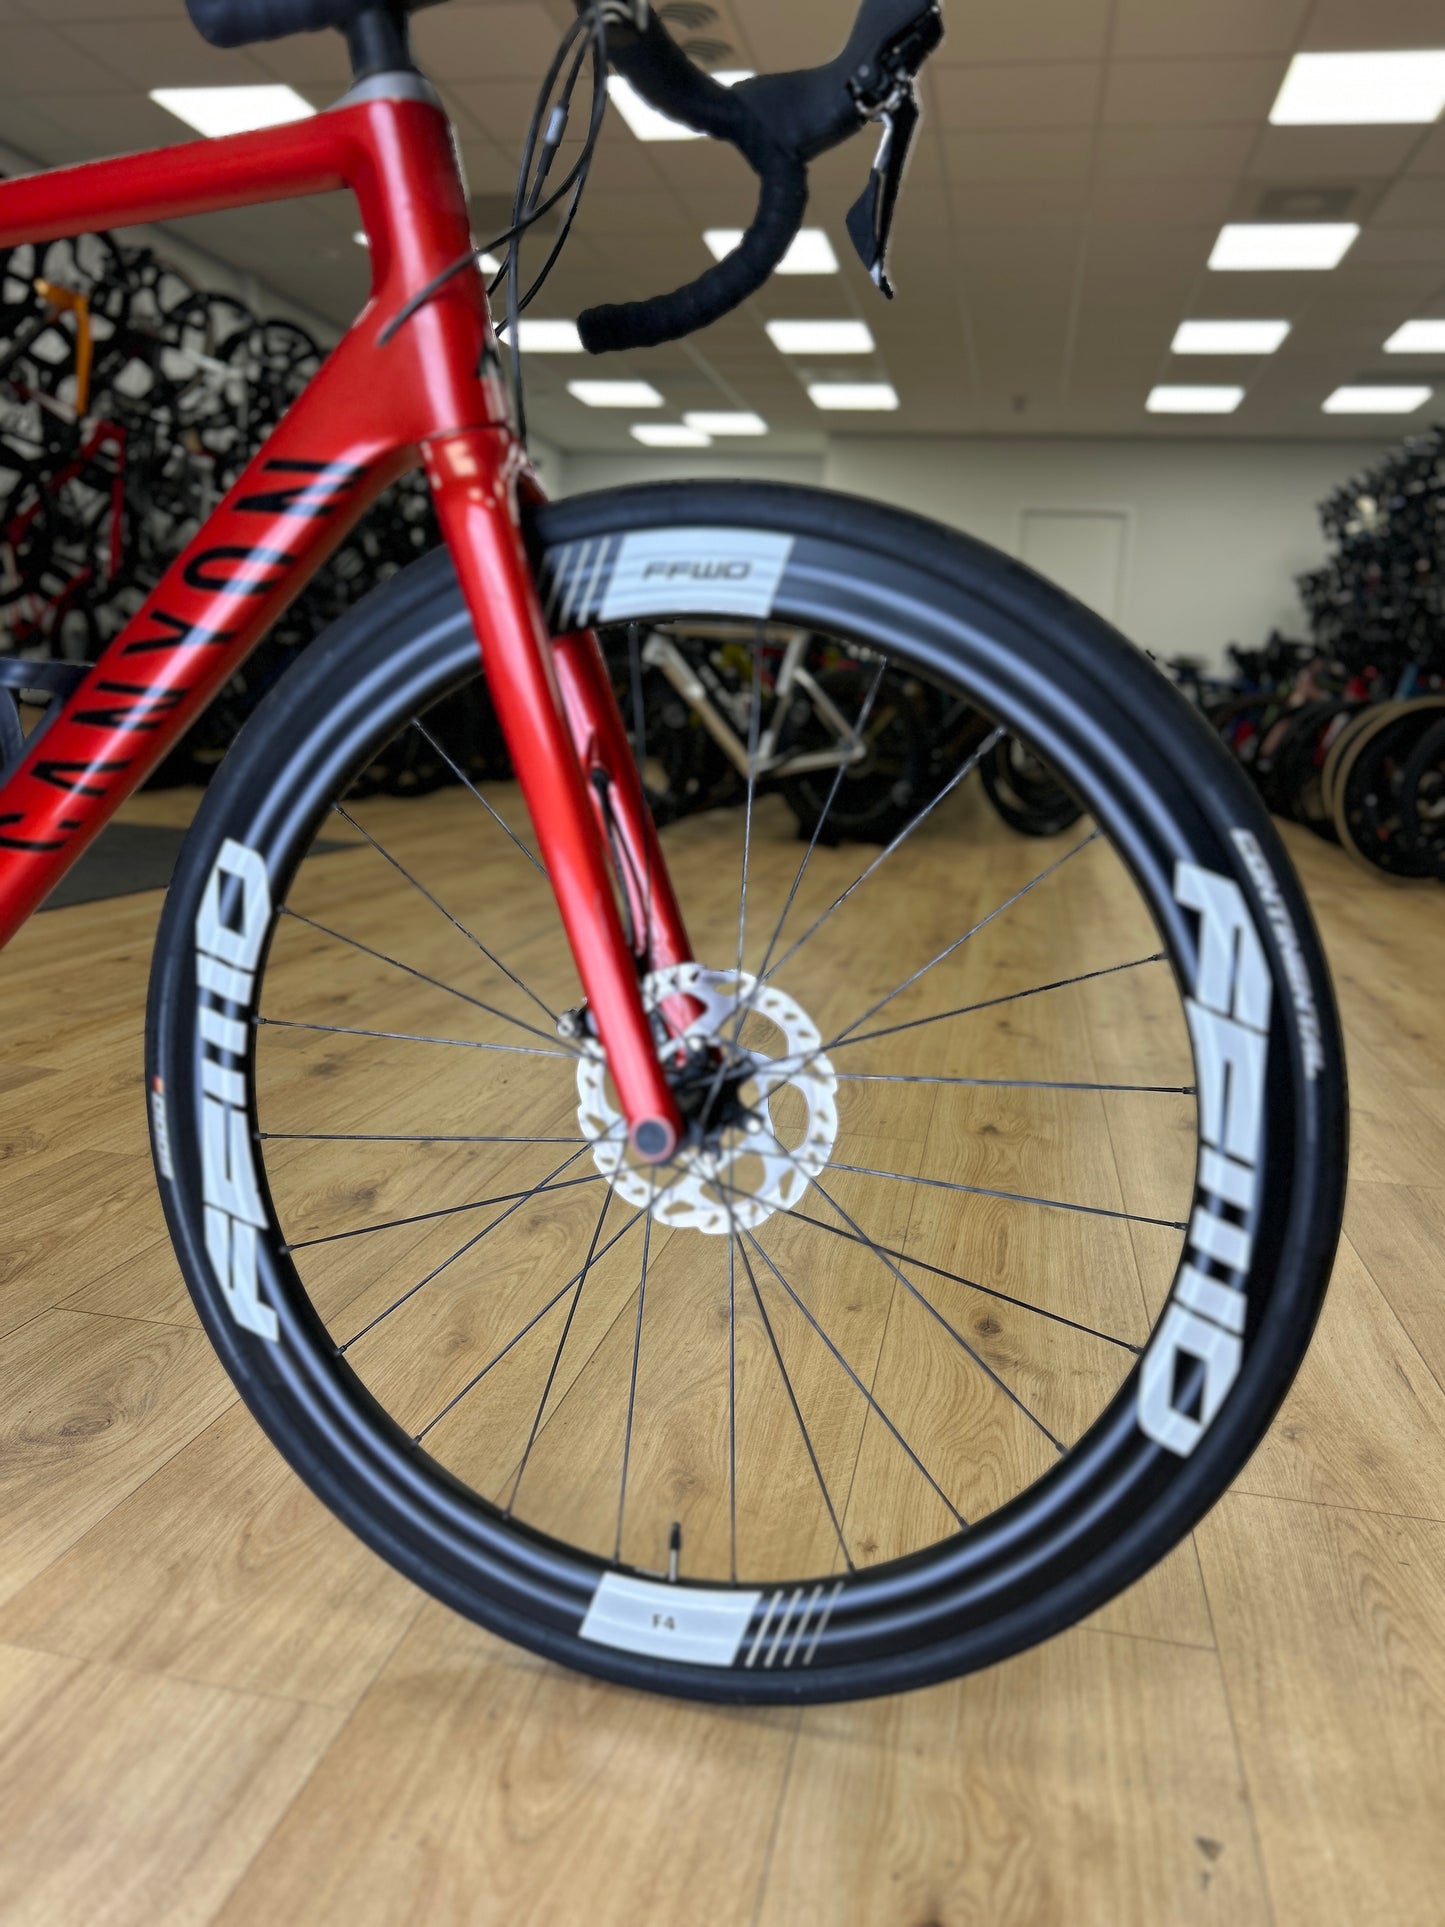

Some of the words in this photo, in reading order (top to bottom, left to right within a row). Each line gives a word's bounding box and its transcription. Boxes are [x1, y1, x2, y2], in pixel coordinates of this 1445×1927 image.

[642, 560, 753, 581] FFWD
[0, 459, 371, 852] CANYON
[653, 1612, 677, 1632] F4
